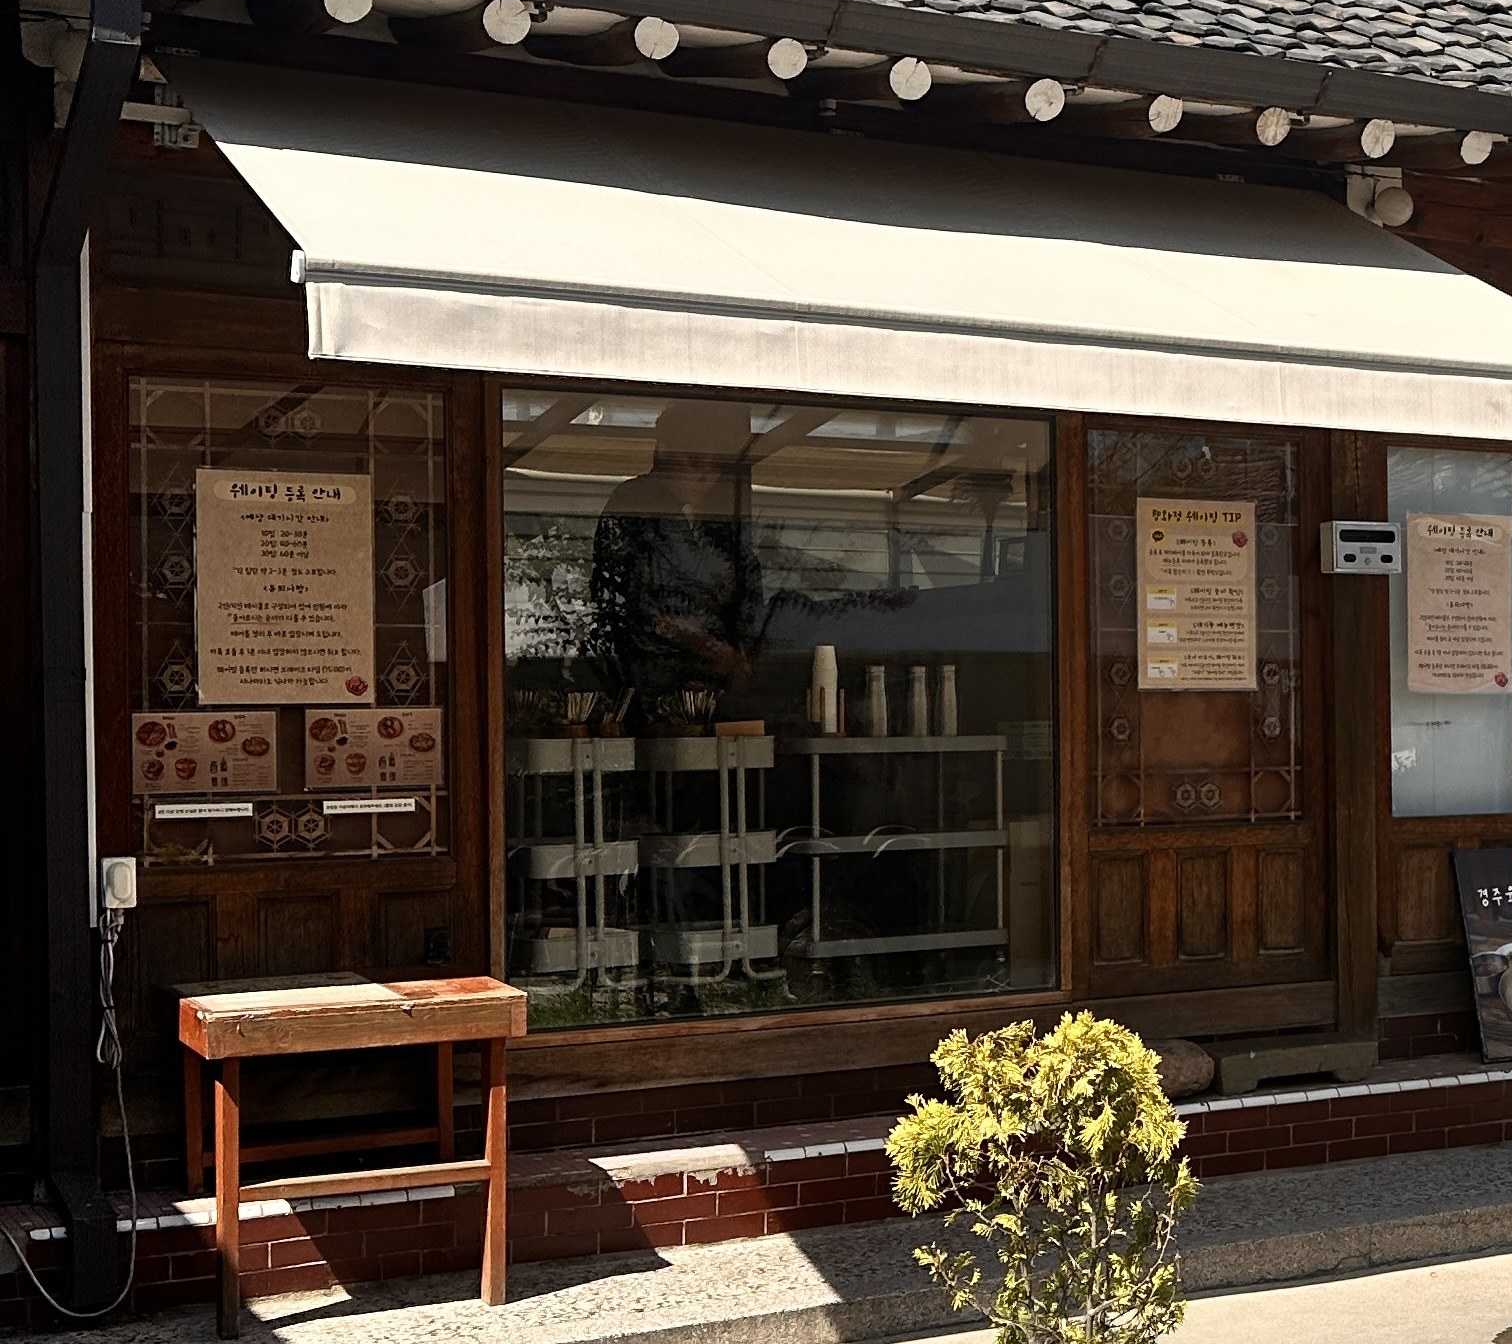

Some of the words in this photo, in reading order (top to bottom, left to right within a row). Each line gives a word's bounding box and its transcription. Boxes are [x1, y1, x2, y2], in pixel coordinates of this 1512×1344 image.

[230, 483, 278, 499] 웨이팅
[285, 485, 305, 502] 등록
[312, 488, 341, 500] 안내
[267, 514, 304, 523] 대기시간
[1186, 510, 1218, 523] 웨이팅
[1222, 512, 1241, 522] TIP
[1427, 524, 1456, 536] 웨이팅
[1459, 526, 1471, 539] 등록
[1476, 528, 1493, 537] 안내
